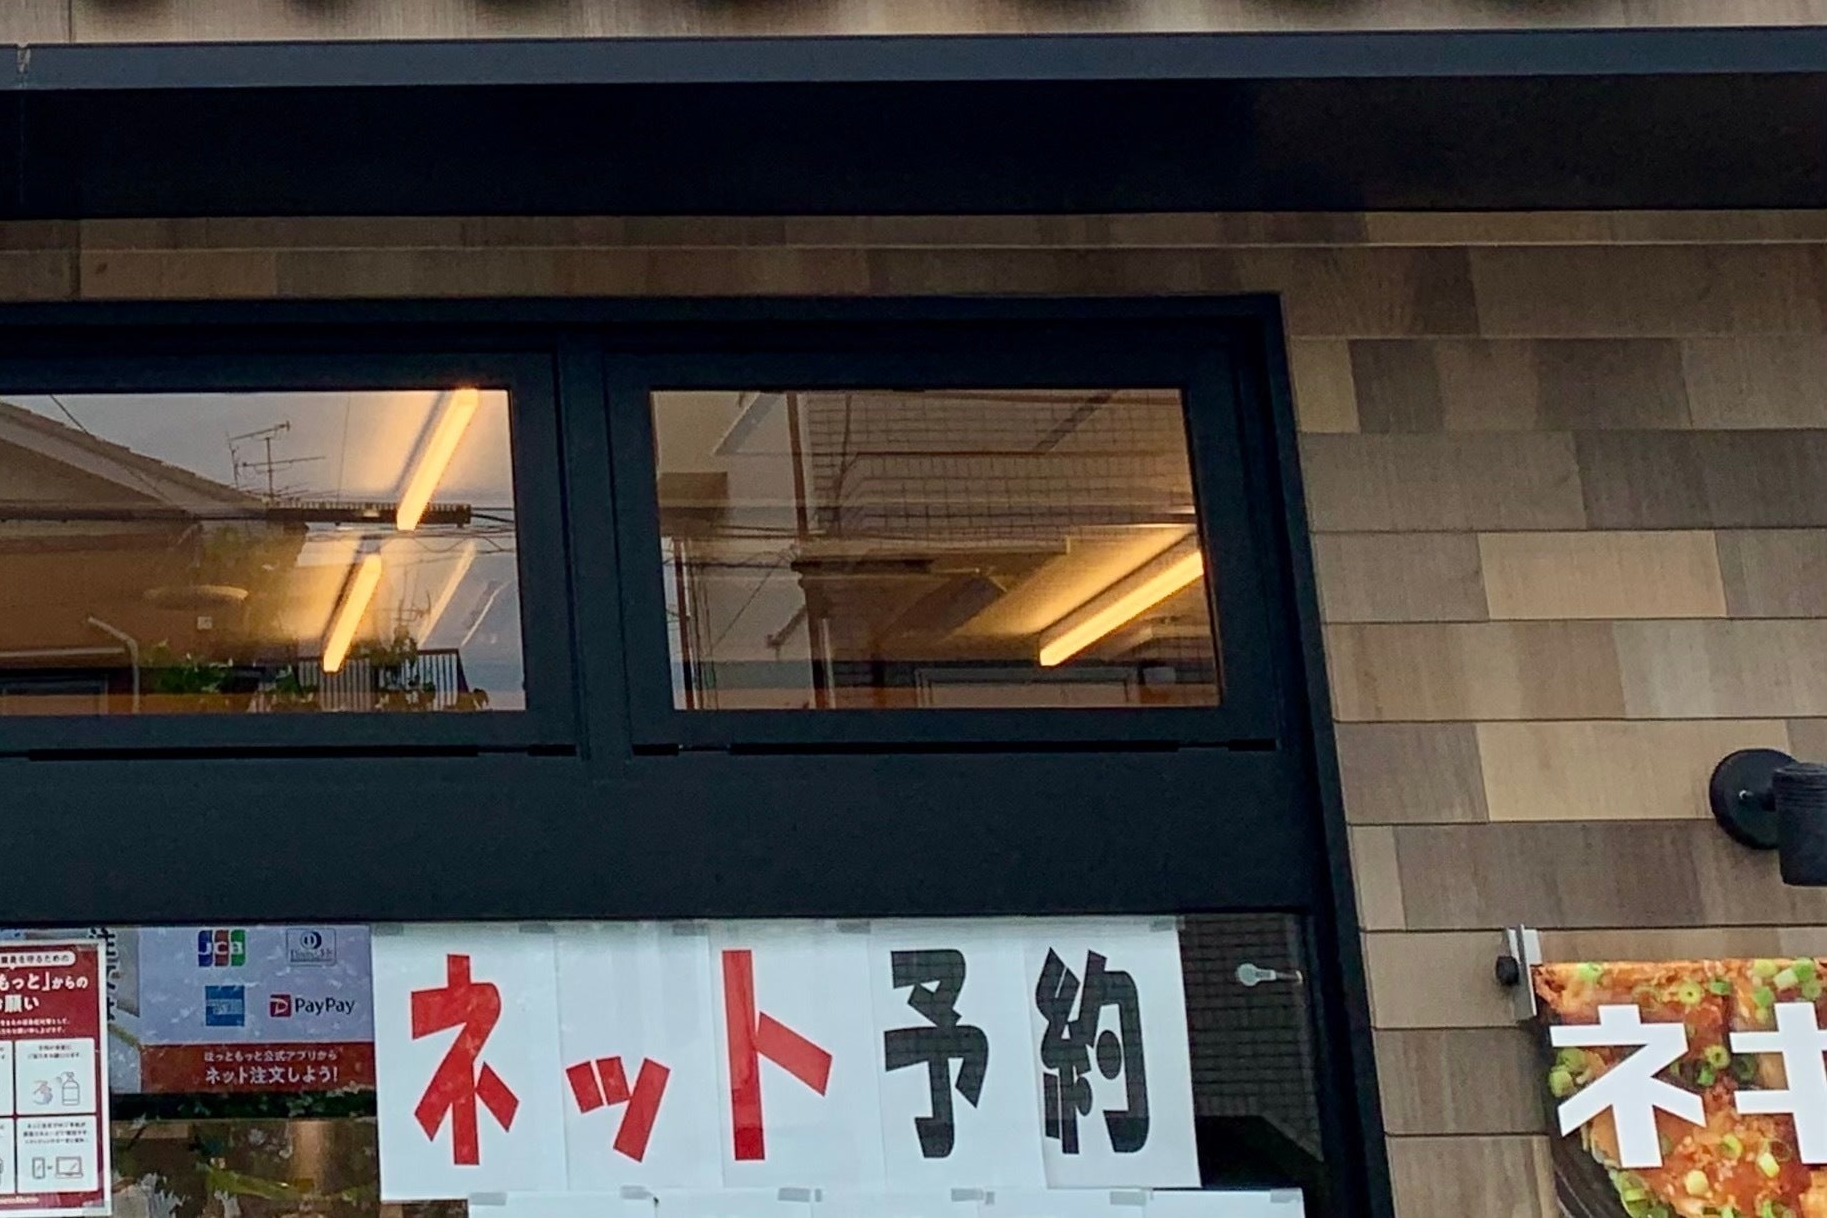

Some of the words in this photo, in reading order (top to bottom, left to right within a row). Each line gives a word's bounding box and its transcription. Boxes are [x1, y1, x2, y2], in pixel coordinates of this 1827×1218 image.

[294, 997, 355, 1015] PayPay
[204, 1049, 338, 1062] ほっともっと公式アプリから
[410, 947, 1150, 1166] ネット予約
